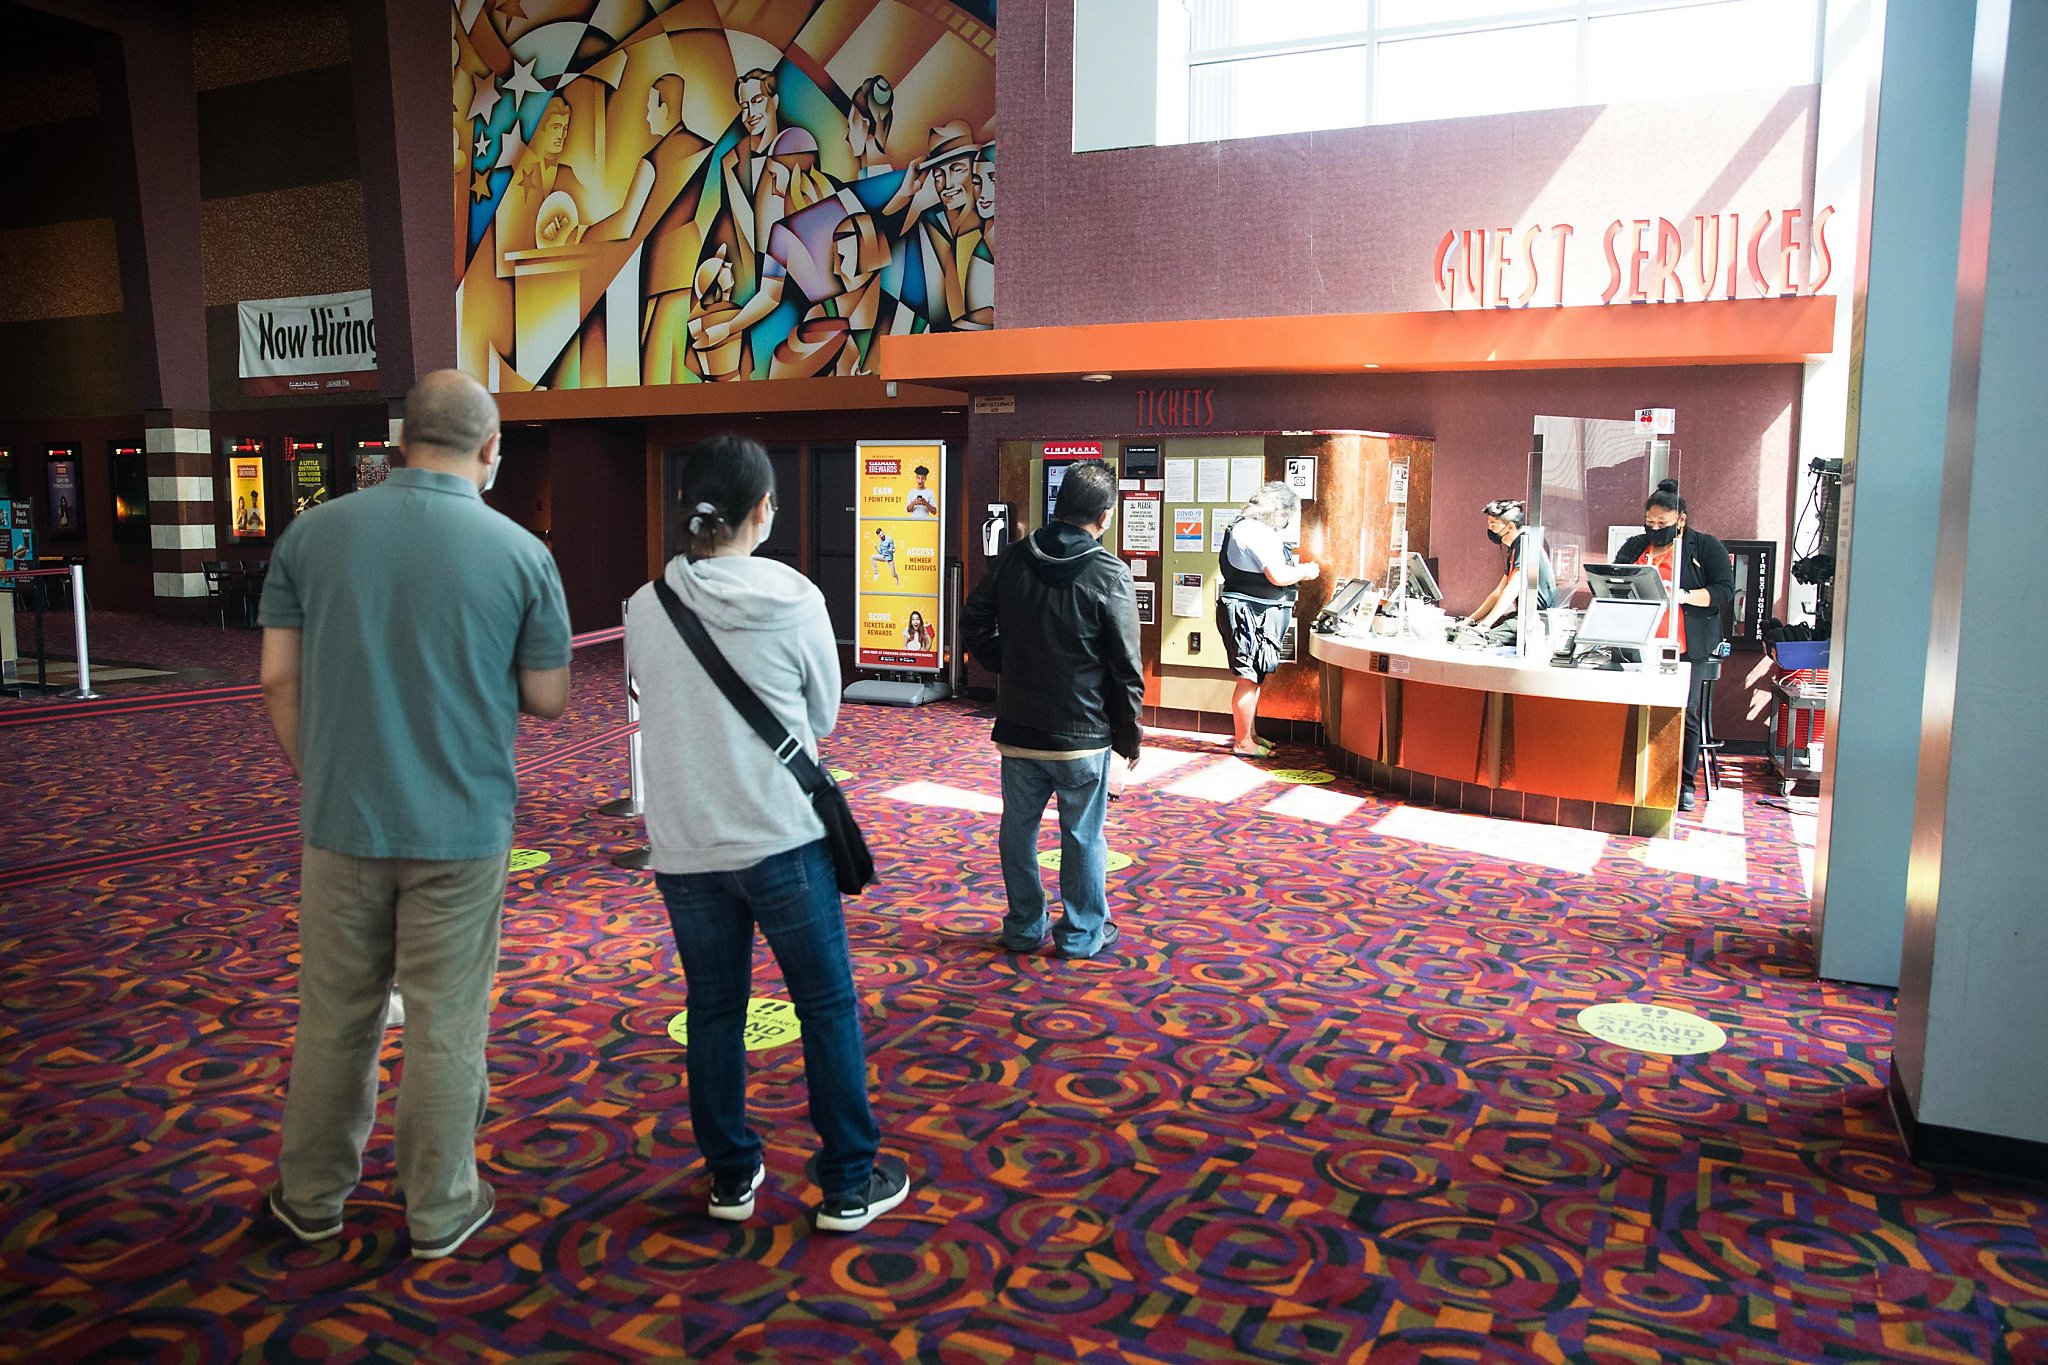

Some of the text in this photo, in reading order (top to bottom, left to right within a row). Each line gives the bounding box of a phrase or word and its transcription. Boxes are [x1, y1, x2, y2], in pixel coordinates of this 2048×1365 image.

[1433, 204, 1836, 309] GUEST SERVICES
[259, 312, 308, 360] Now
[1136, 388, 1214, 427] TICKETS
[1044, 446, 1100, 455] CINEMARK
[360, 464, 391, 472] BROKEN
[362, 472, 390, 480] HEARTS
[873, 487, 893, 495] EARN
[906, 548, 934, 556] ACCESS
[868, 612, 891, 621] SCORE
[1598, 1016, 1705, 1038] STAND
[1596, 1024, 1704, 1046] APART
